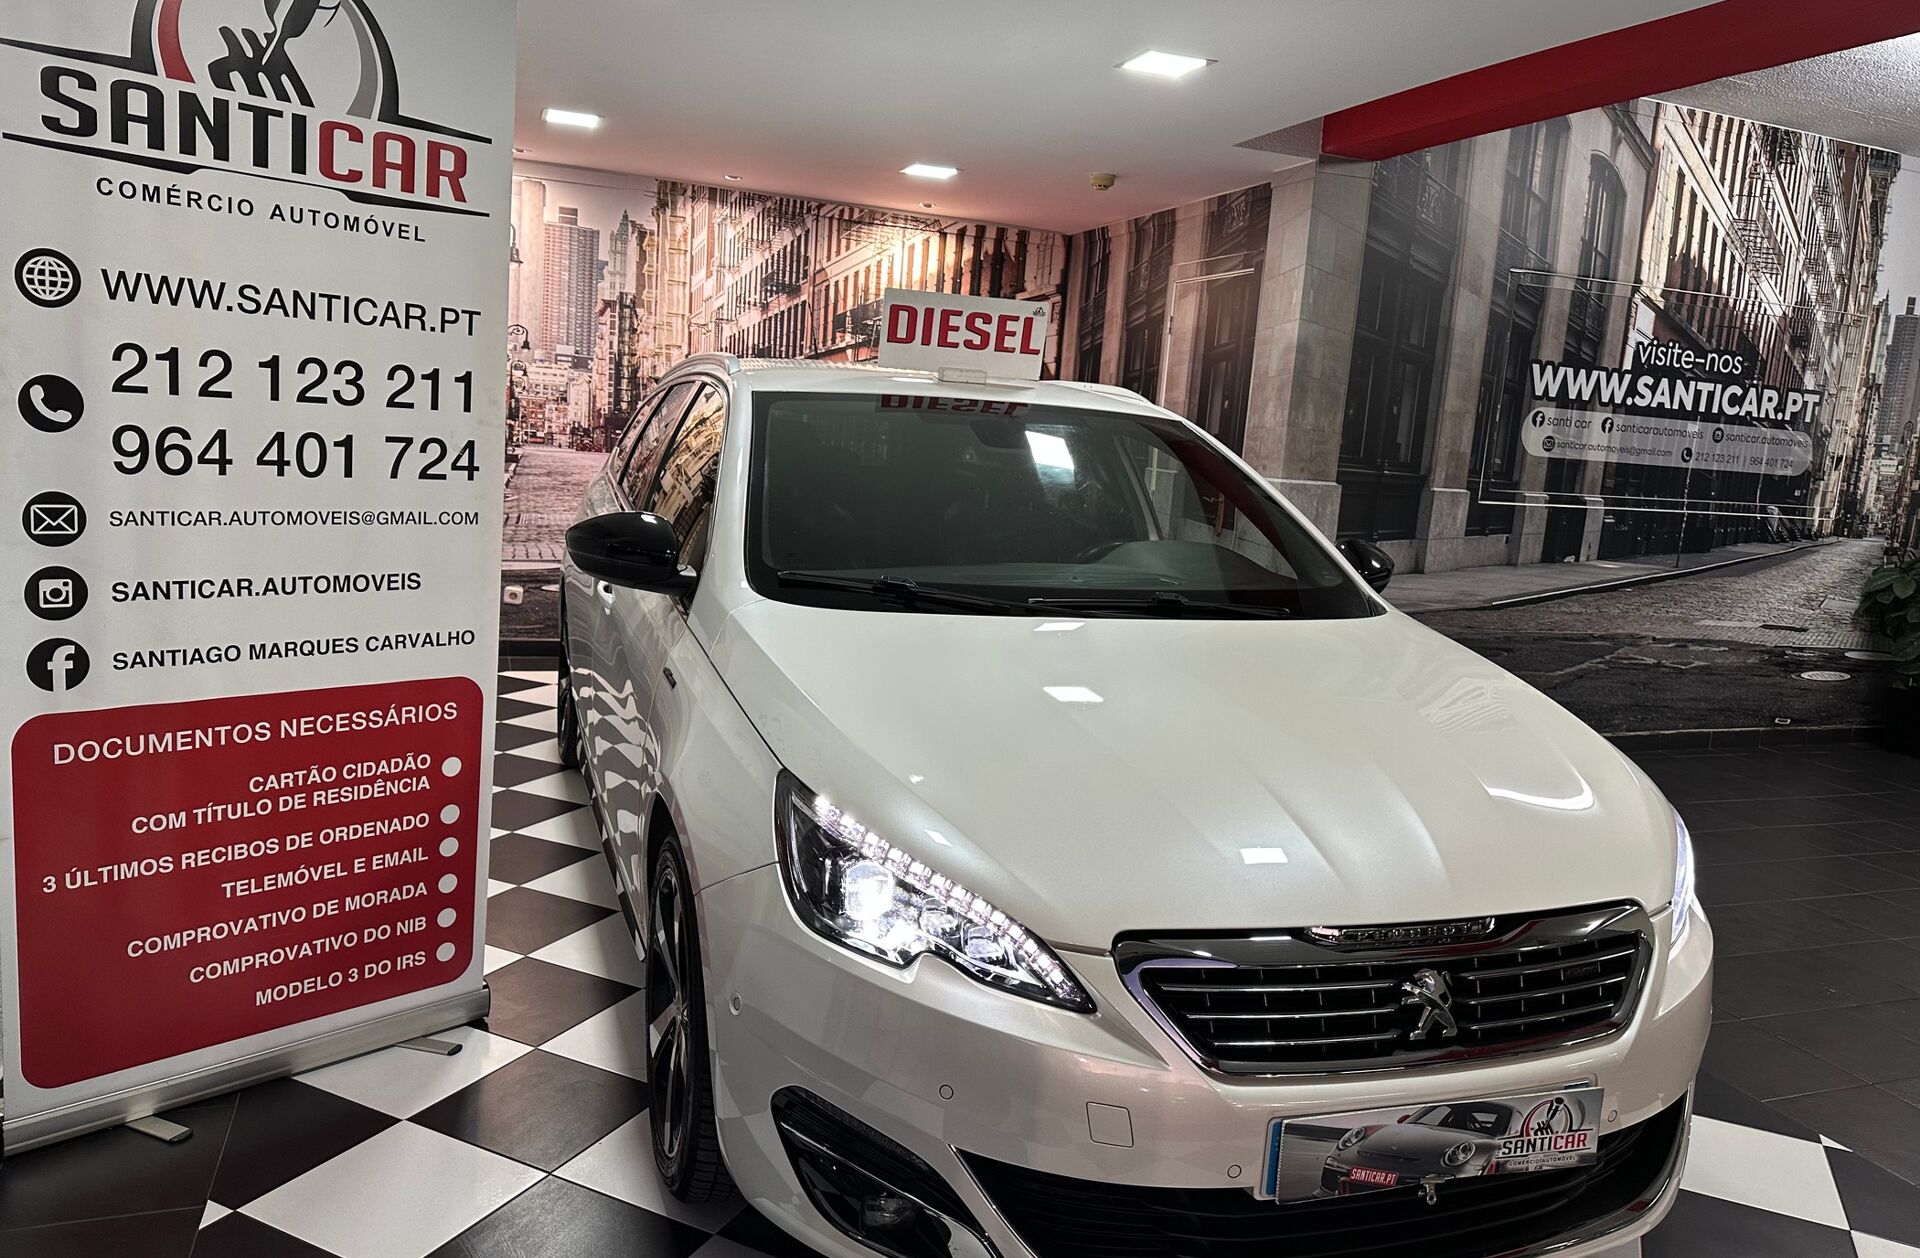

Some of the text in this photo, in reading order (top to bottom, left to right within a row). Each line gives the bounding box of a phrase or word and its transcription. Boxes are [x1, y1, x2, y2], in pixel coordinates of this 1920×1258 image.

[39, 64, 468, 203] SANTICAR
[96, 176, 426, 243] COMÉRCIO AUTOMÓVEL
[99, 268, 482, 337] WWW.SANTICAR.PT
[886, 303, 1041, 356] DIESEL
[110, 341, 474, 413] 212 123 211
[1638, 340, 1744, 375] visite-nos
[1531, 363, 1821, 423] WWW.SANTICAR.PT
[110, 424, 480, 482] 964 401 724
[108, 510, 480, 528] SANTICAR.AUTOMOVEIS@GMAIL.COM
[110, 572, 422, 603] SANTICAR.AUTOMOVEIS
[111, 629, 476, 671] SANTIAGO MARQUES CARVALHO
[53, 701, 459, 765] DOCUMENTOS NECESSÁRIOS
[248, 753, 431, 794] CARTÃO CIDADÃO
[130, 775, 431, 834] COM TÍTULO DE RESIDÊNCIA
[41, 812, 430, 894] 3 ÚLTIMOS RECIBOS DE ORDENADO
[221, 847, 429, 899] TELEMÓVEL E EMAIL
[126, 881, 428, 958] COMPROVATIVO DE MORADA
[189, 915, 427, 984] COMPROVATIVO DO NIB
[255, 950, 427, 1007] MODELO 3 DO IRS
[1501, 1132, 1588, 1156] SANTICAR
[1350, 1168, 1397, 1185] SANTICAR.PT
